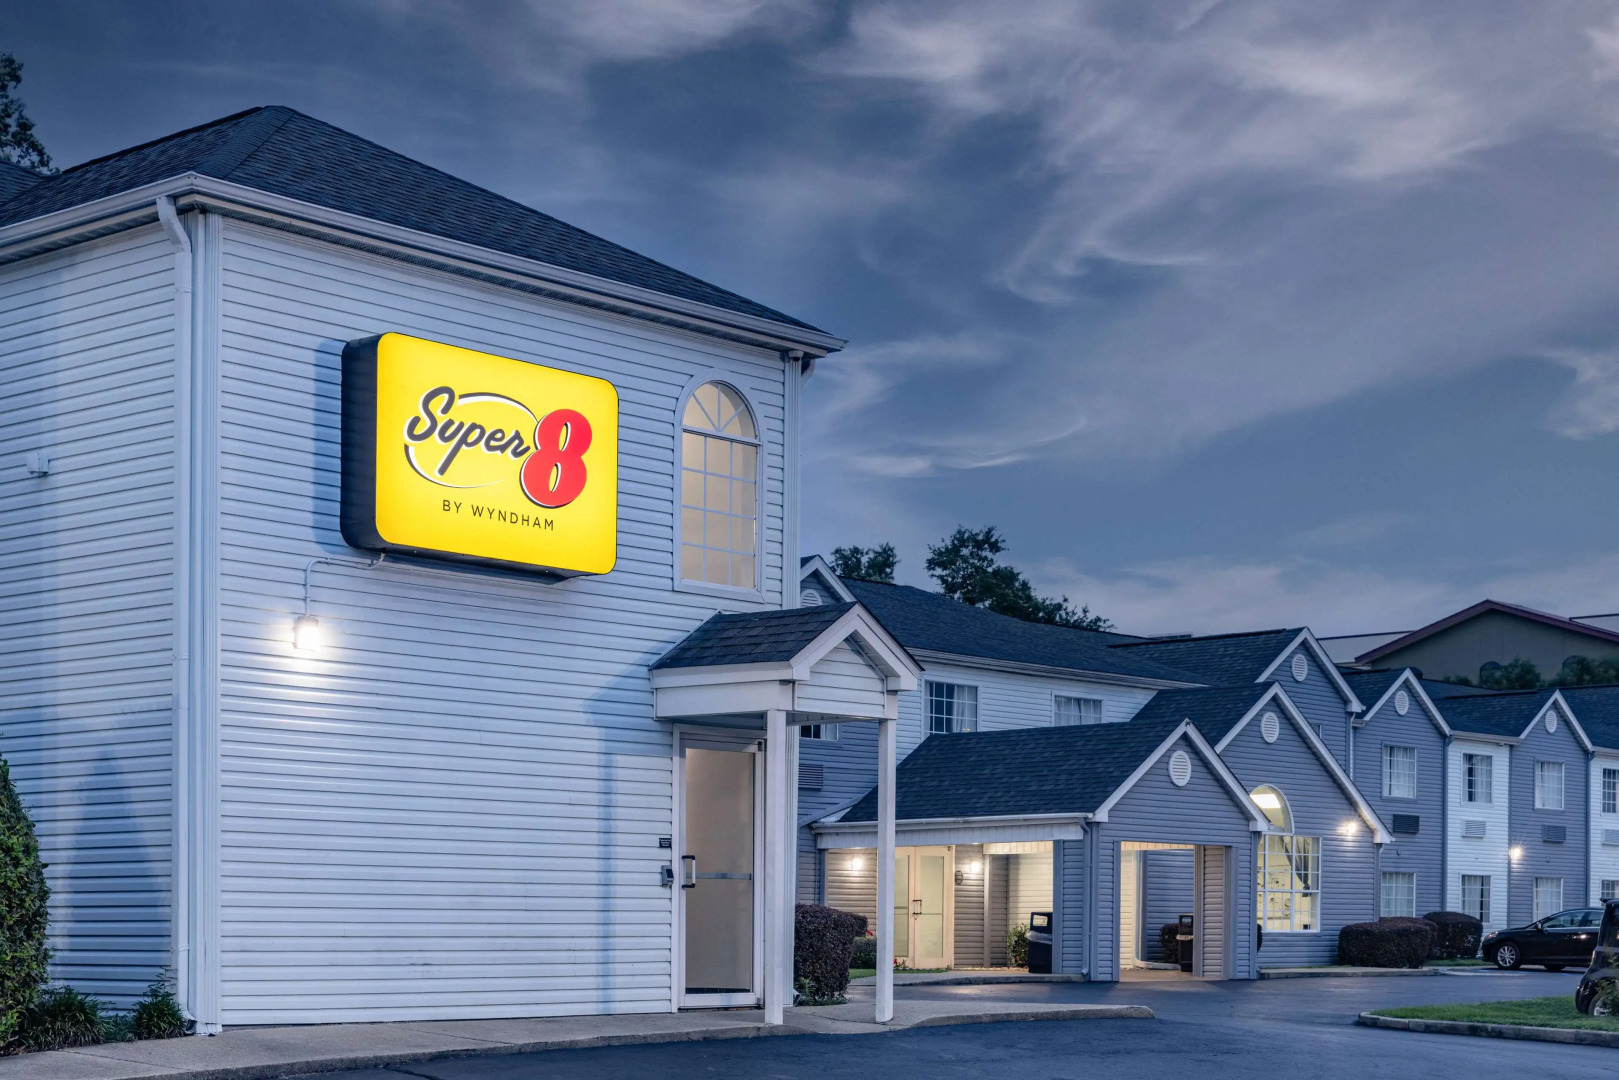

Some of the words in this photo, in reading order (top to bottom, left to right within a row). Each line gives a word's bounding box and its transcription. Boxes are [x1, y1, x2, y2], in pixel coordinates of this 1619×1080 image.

[404, 386, 531, 476] Super
[520, 408, 593, 509] 8
[442, 499, 462, 514] BY
[471, 504, 554, 531] WYNDHAM
